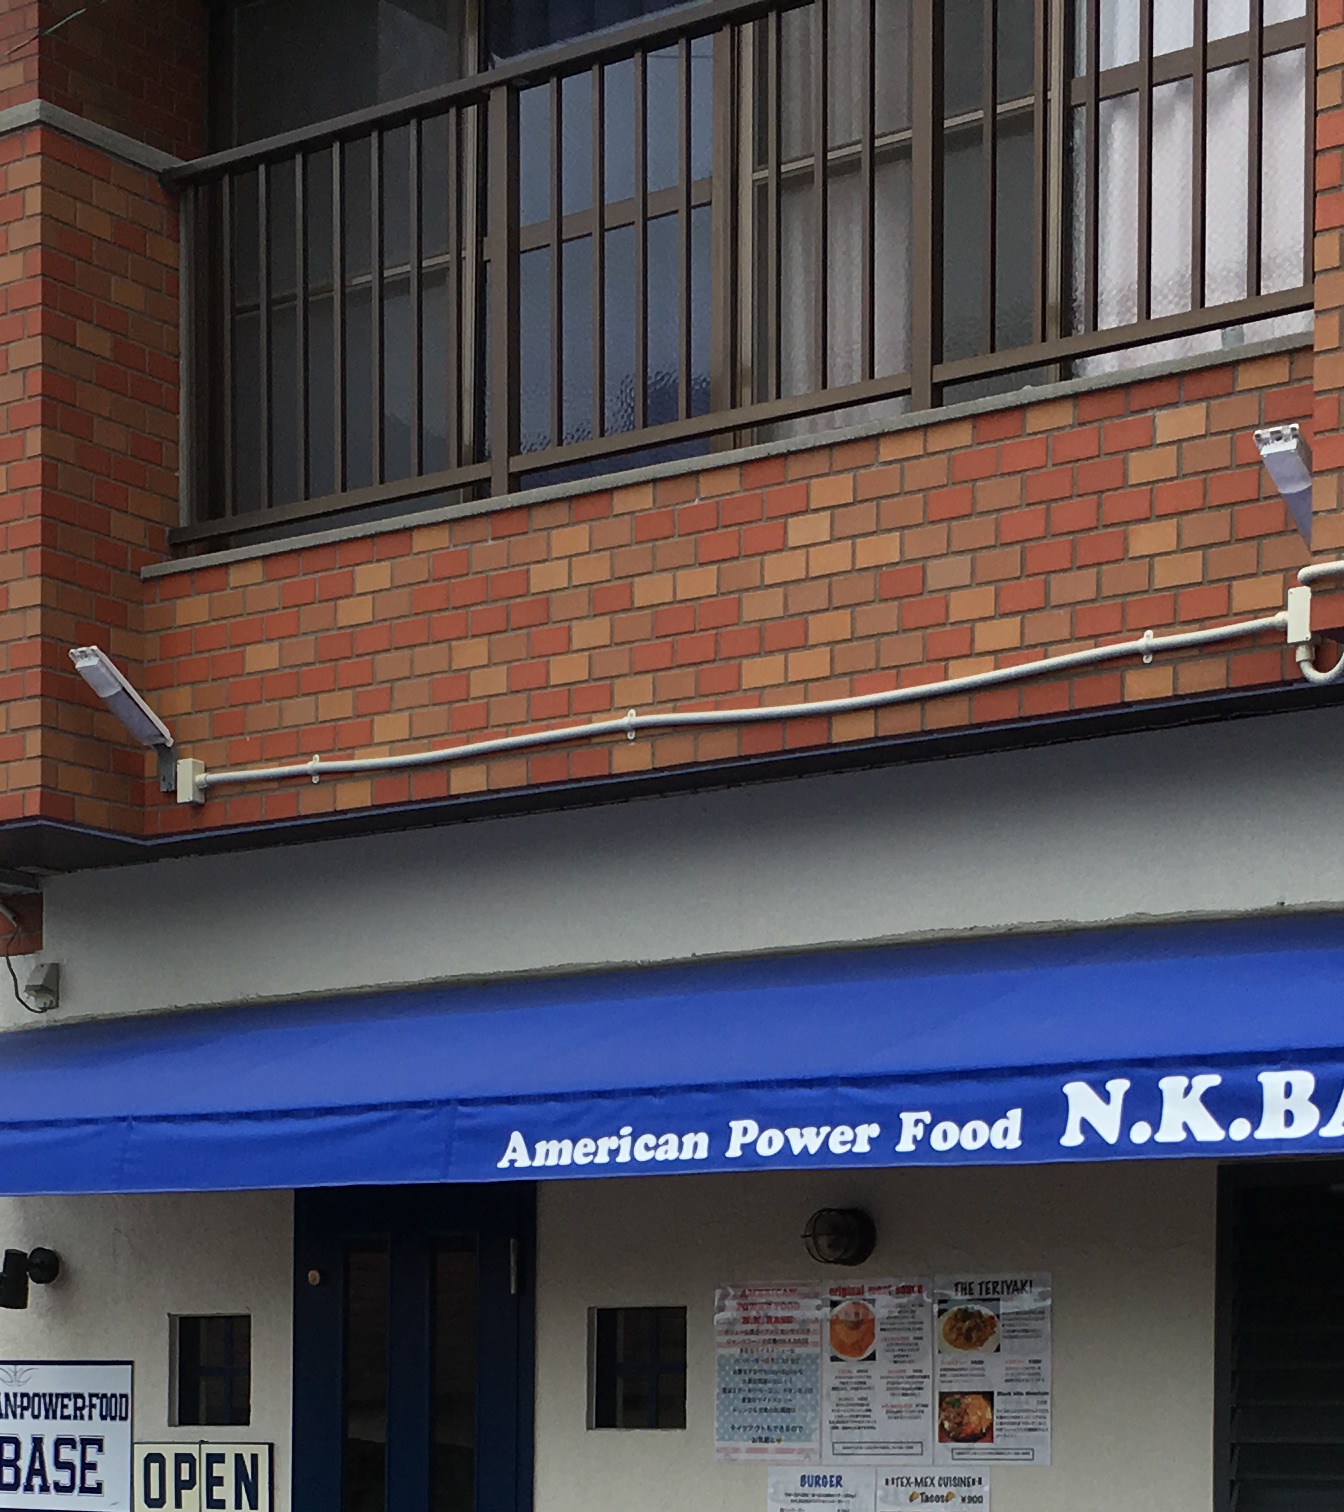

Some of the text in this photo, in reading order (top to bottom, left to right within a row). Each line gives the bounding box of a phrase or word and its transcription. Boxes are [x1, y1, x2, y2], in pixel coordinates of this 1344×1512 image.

[496, 1126, 709, 1168] American
[725, 1119, 881, 1158] Power
[895, 1108, 1022, 1152] Food
[954, 1279, 1034, 1296] THE TERIYAKI
[143, 1452, 259, 1511] OPEN
[799, 1474, 844, 1489] BURGER
[895, 1476, 973, 1488] TEX-MEX CUISINE
